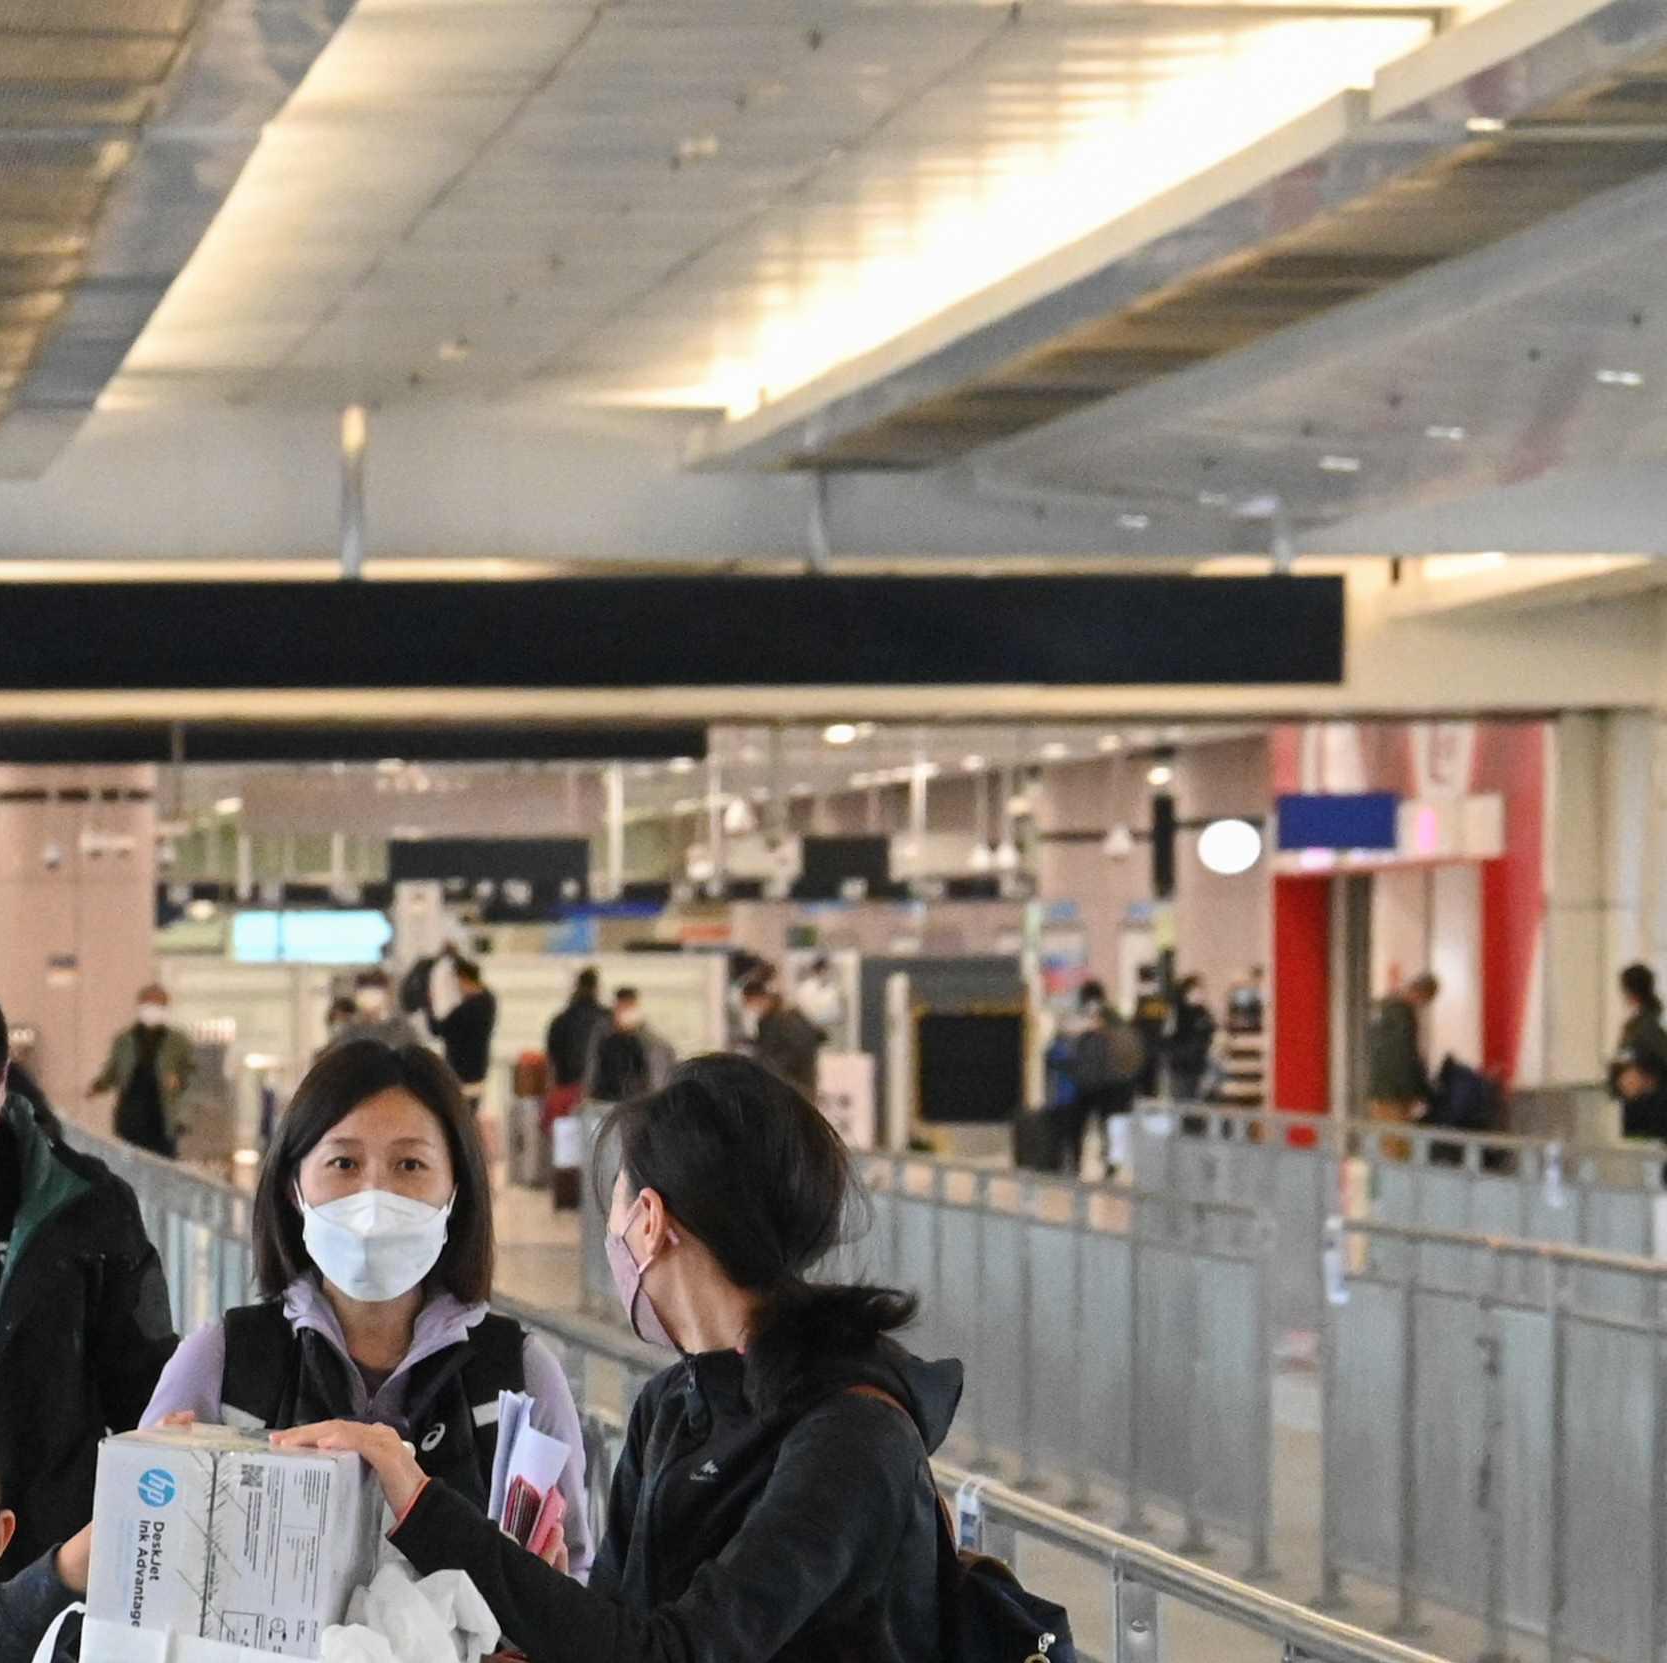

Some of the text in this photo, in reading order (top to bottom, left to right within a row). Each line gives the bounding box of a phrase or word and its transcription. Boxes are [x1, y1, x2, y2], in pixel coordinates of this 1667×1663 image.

[138, 1468, 176, 1508] hp
[130, 1520, 151, 1628] Ink Advantage
[149, 1521, 165, 1581] DeskJet
